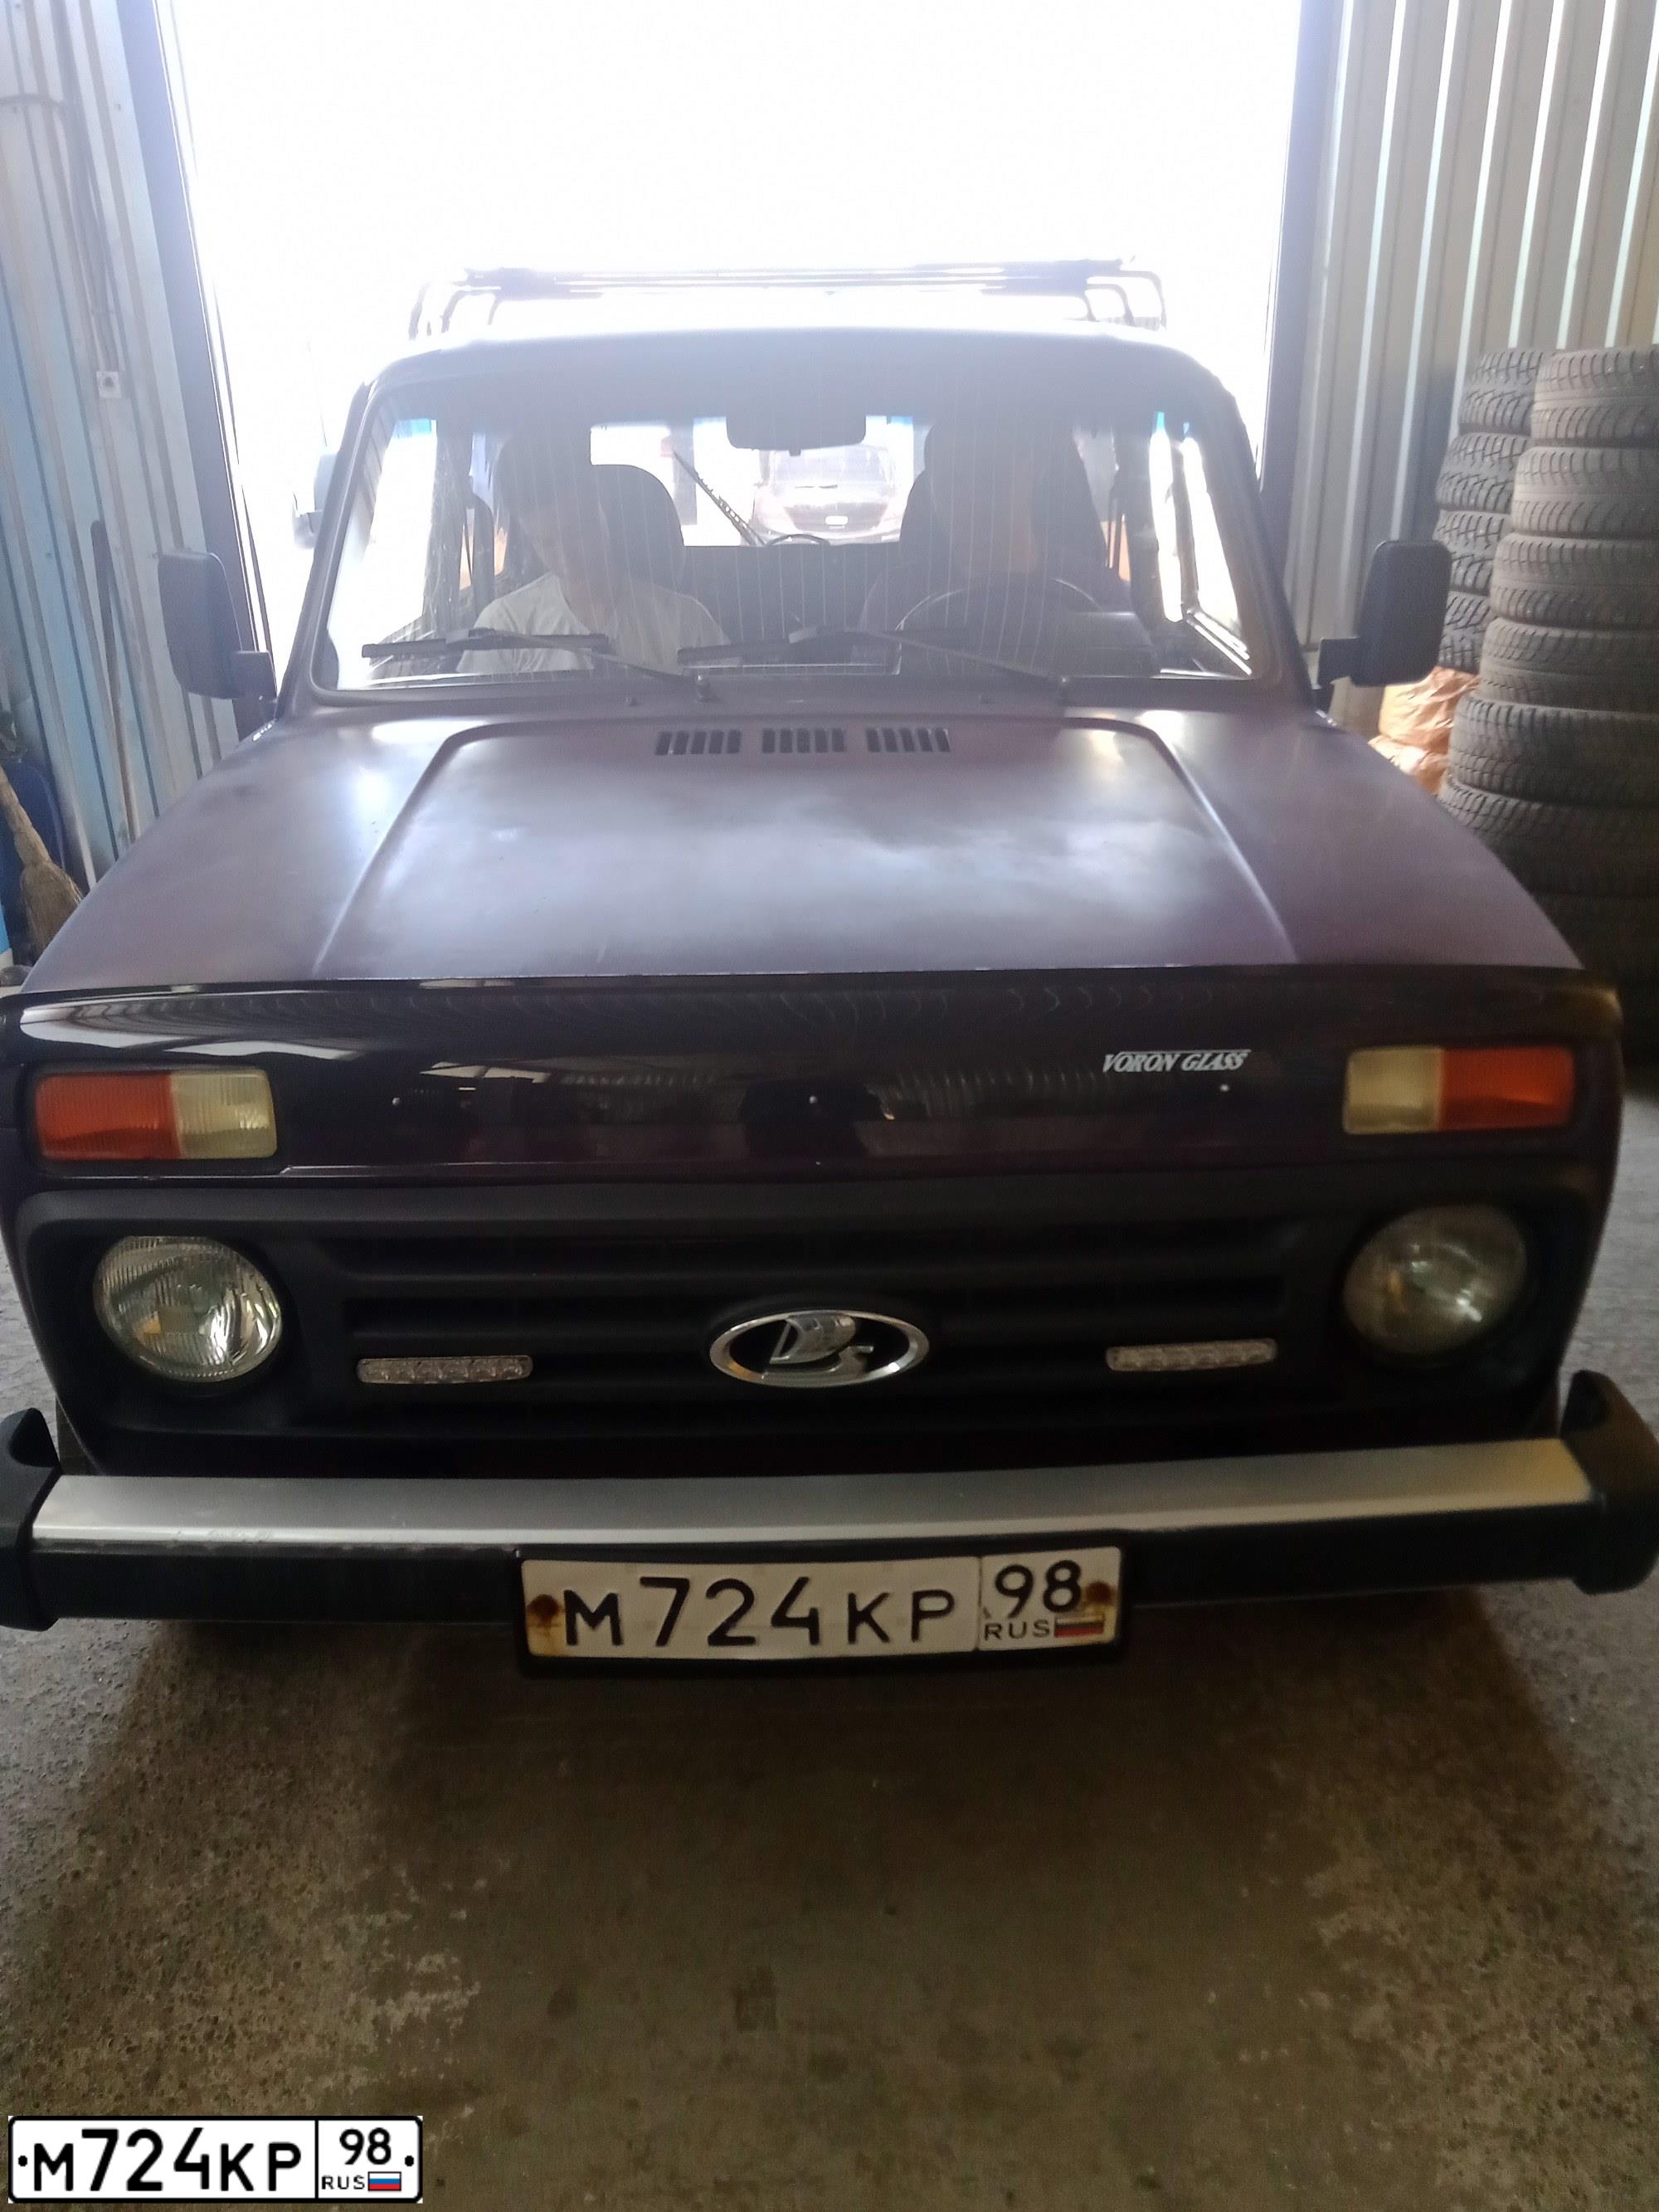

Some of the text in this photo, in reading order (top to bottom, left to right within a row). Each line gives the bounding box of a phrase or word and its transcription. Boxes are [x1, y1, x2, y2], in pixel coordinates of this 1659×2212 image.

[1102, 1050, 1248, 1072] VORON GLASS
[995, 1559, 1083, 1620] 98
[983, 1618, 1052, 1640] RUS
